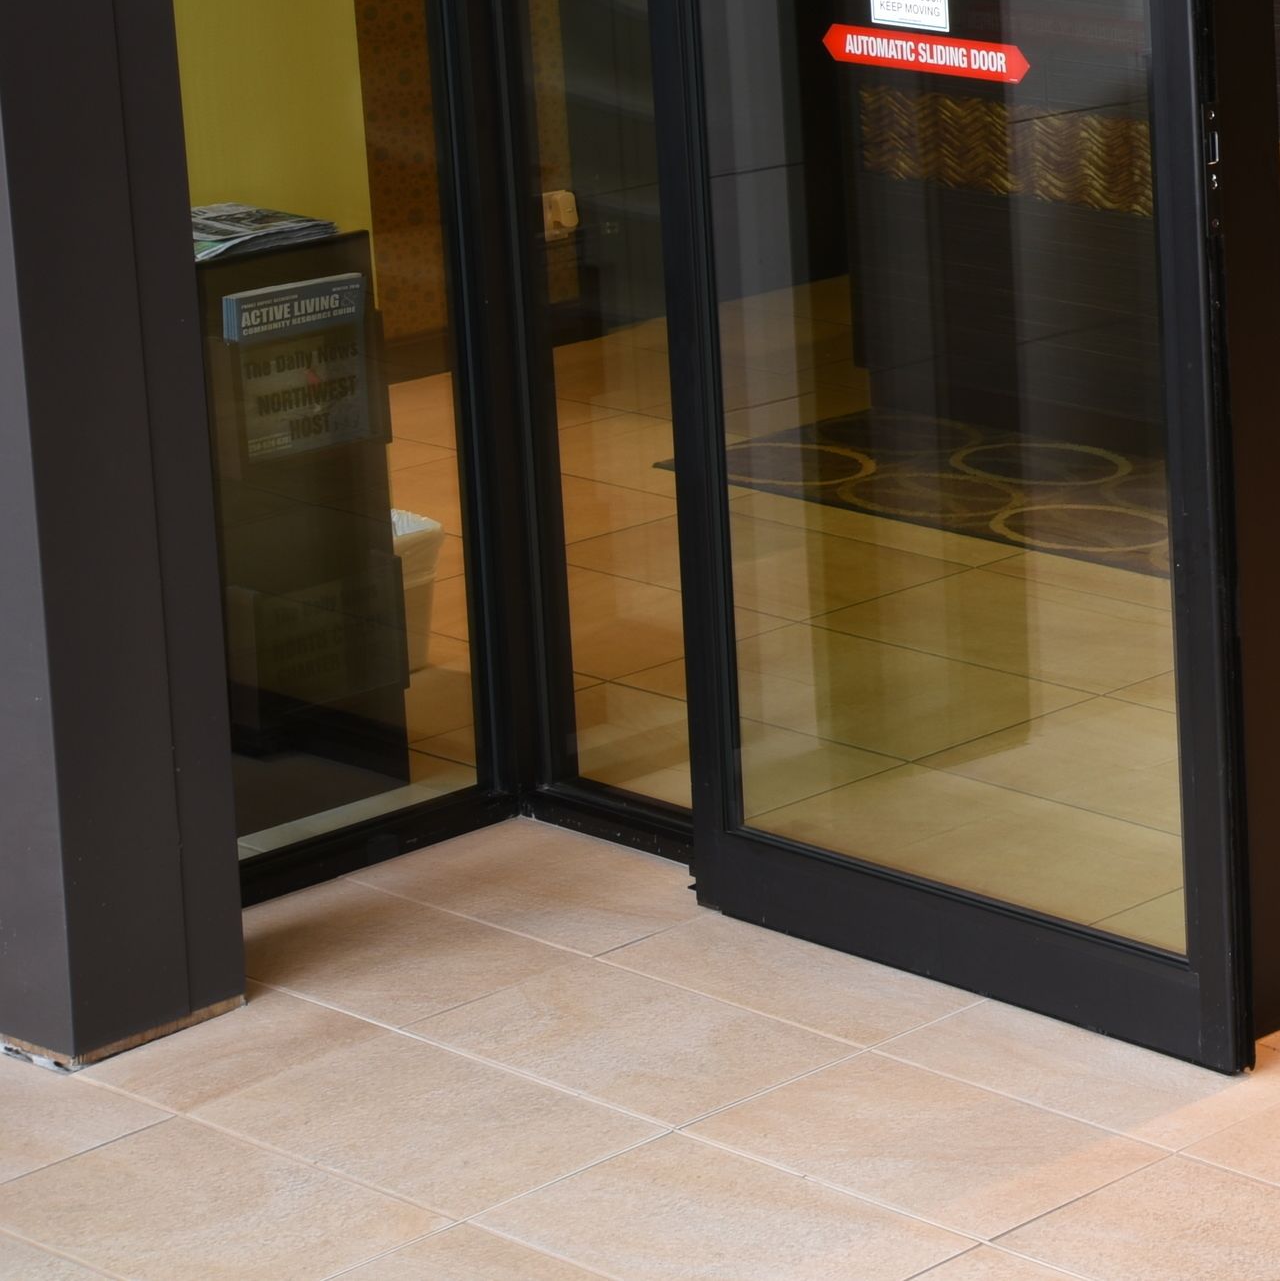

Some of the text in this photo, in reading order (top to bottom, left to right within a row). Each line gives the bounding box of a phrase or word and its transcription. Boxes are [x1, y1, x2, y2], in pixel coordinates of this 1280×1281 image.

[880, 0, 941, 17] KEEP MOVING
[845, 34, 1006, 73] AUTOMATIC SLIDING DOOR
[241, 303, 291, 327] ACTIVE
[294, 294, 340, 316] LIVING
[242, 306, 356, 336] COMMUNITY RESOURCE GUIDE
[246, 342, 358, 379] The Daily News
[256, 375, 356, 416] NORTHWEST
